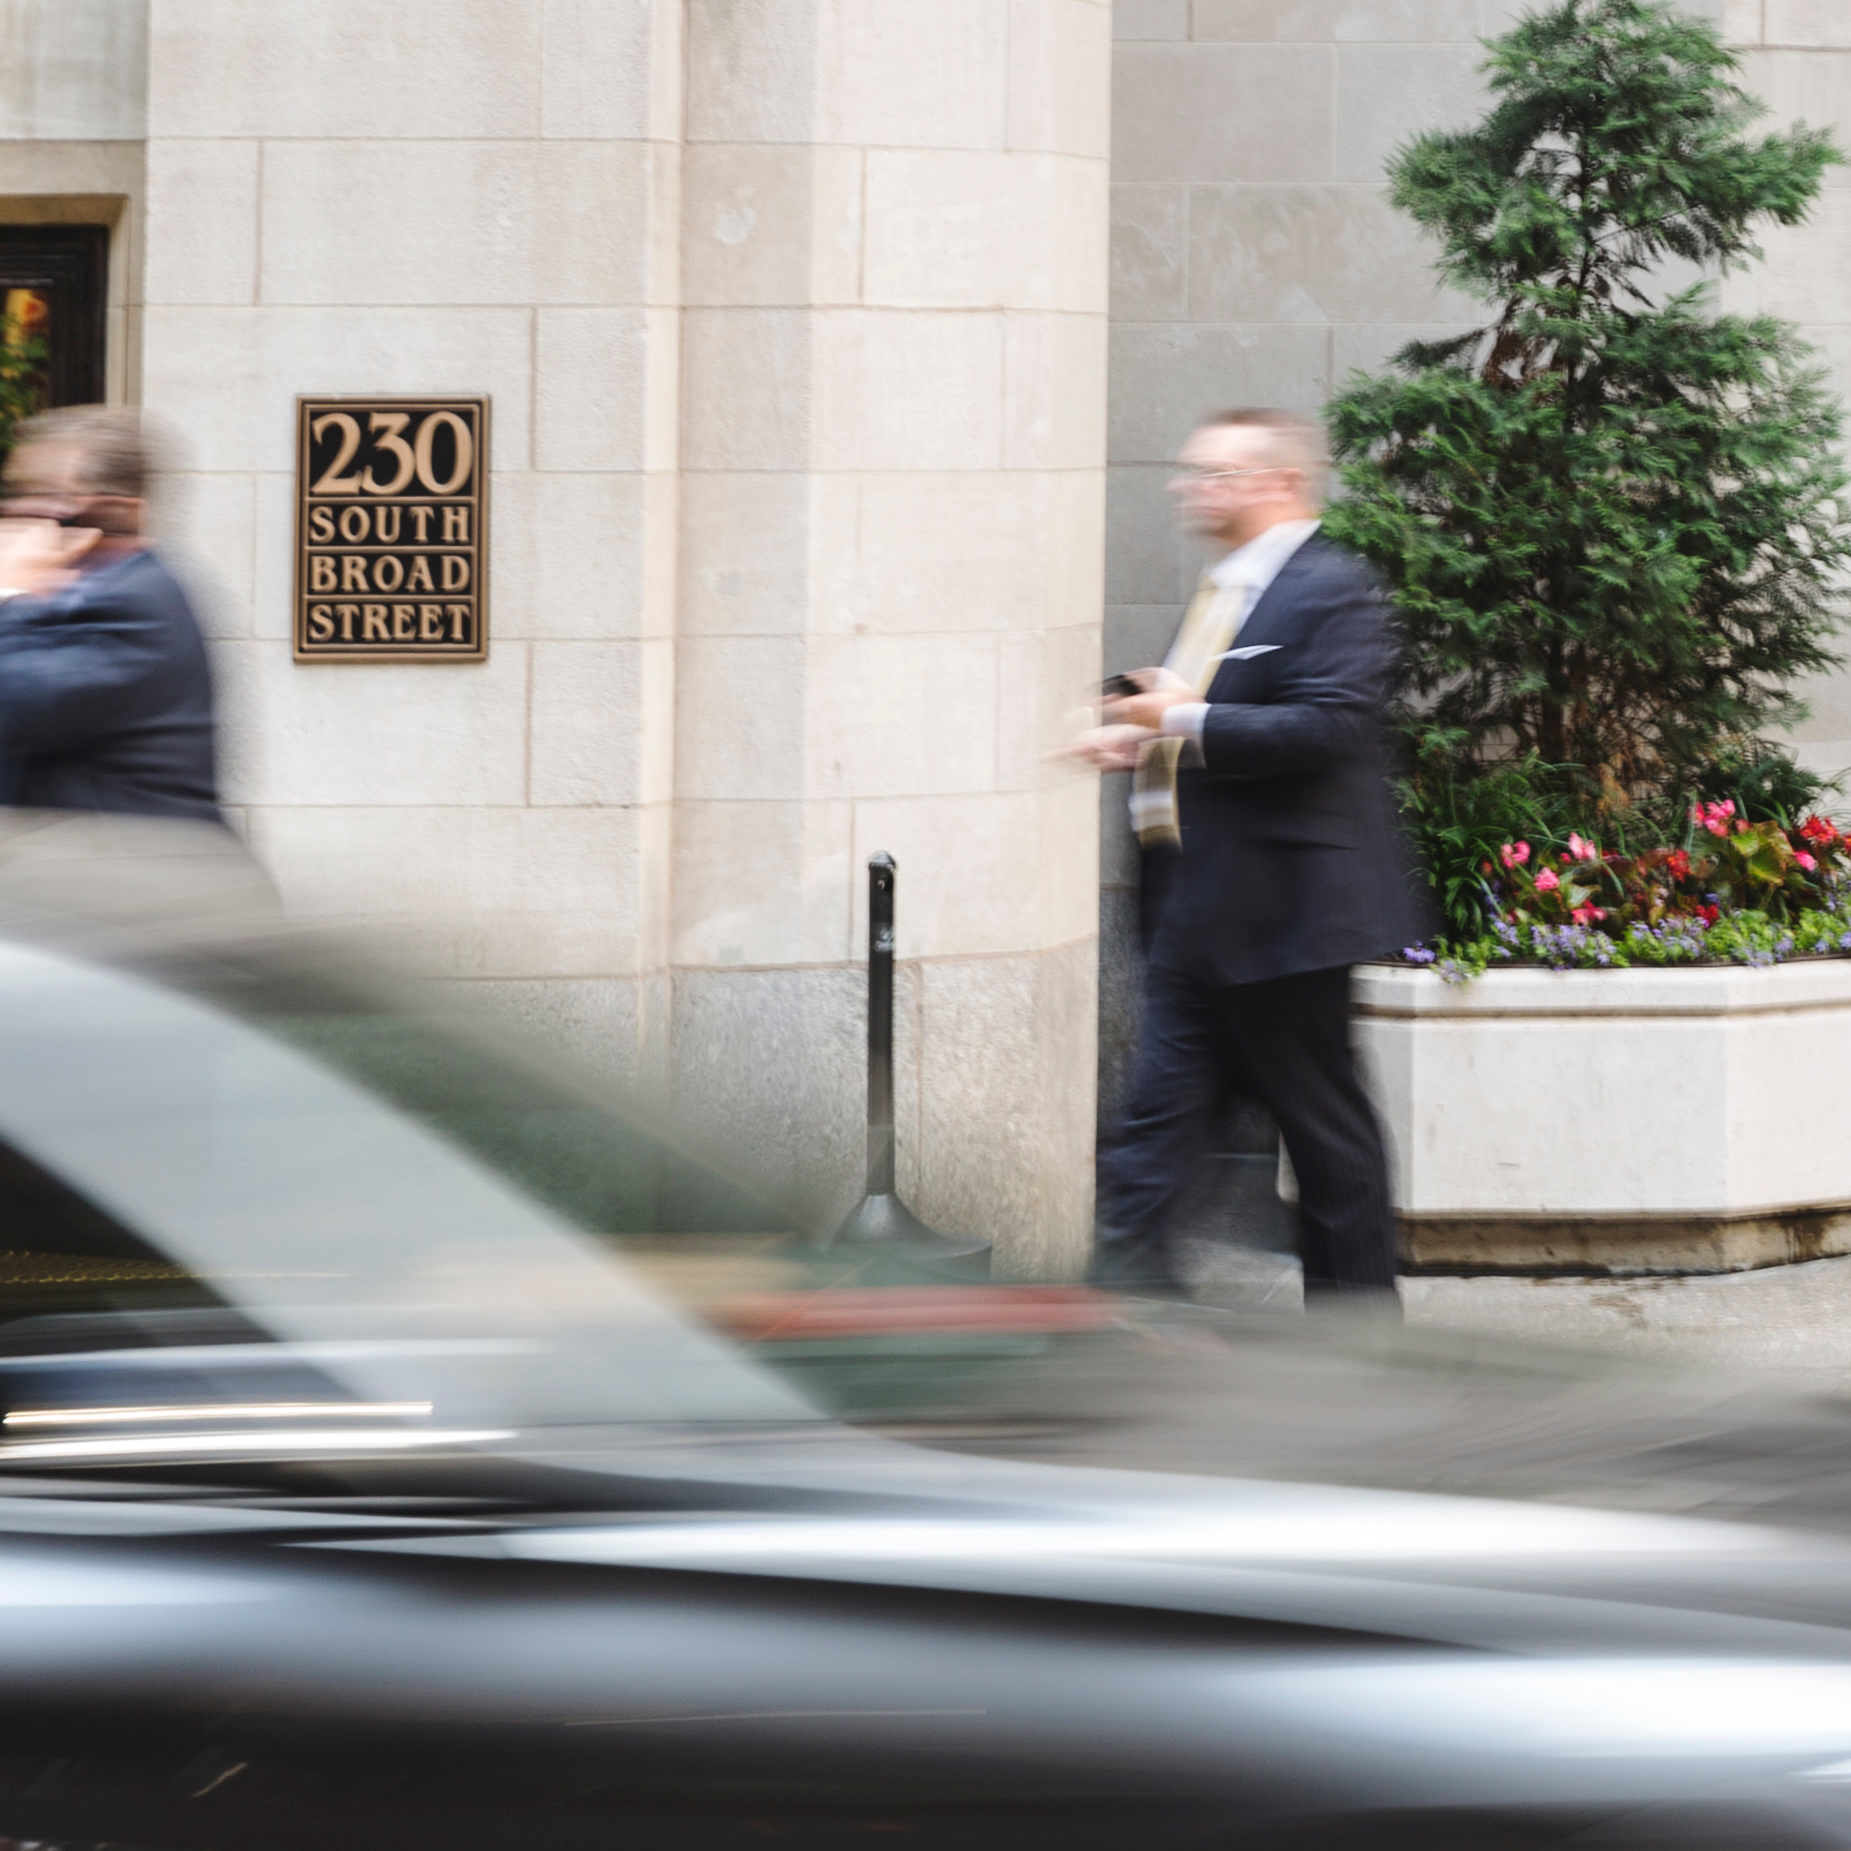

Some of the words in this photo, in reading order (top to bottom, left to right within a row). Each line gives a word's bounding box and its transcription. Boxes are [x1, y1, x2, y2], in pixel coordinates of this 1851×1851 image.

[310, 411, 474, 496] 230
[309, 505, 471, 544] SOUTH
[309, 555, 471, 593] BROAD
[309, 604, 472, 642] STREET
